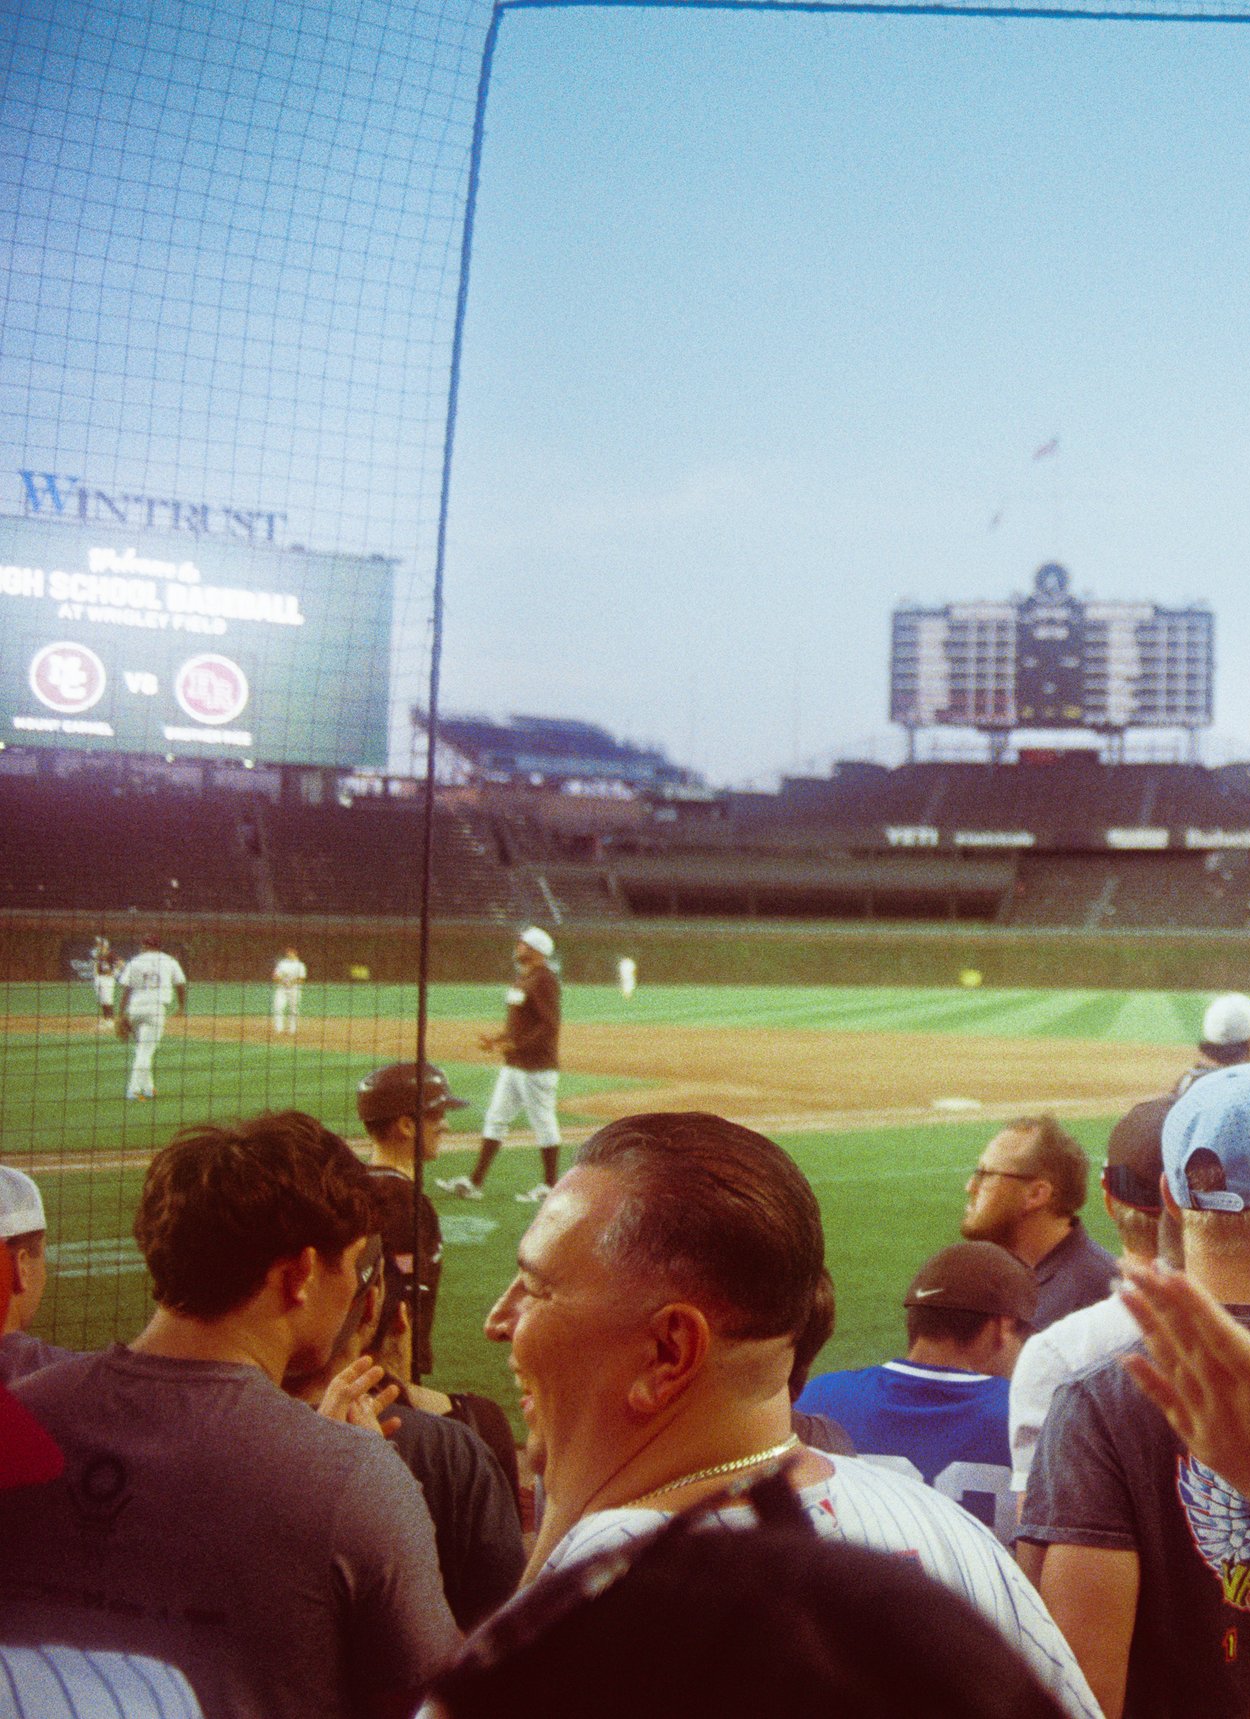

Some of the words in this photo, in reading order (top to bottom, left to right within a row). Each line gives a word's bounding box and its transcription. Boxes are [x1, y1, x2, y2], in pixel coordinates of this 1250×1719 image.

[18, 469, 288, 542] WINTRUST
[50, 571, 161, 610] SCHOOL
[58, 603, 82, 620] AT
